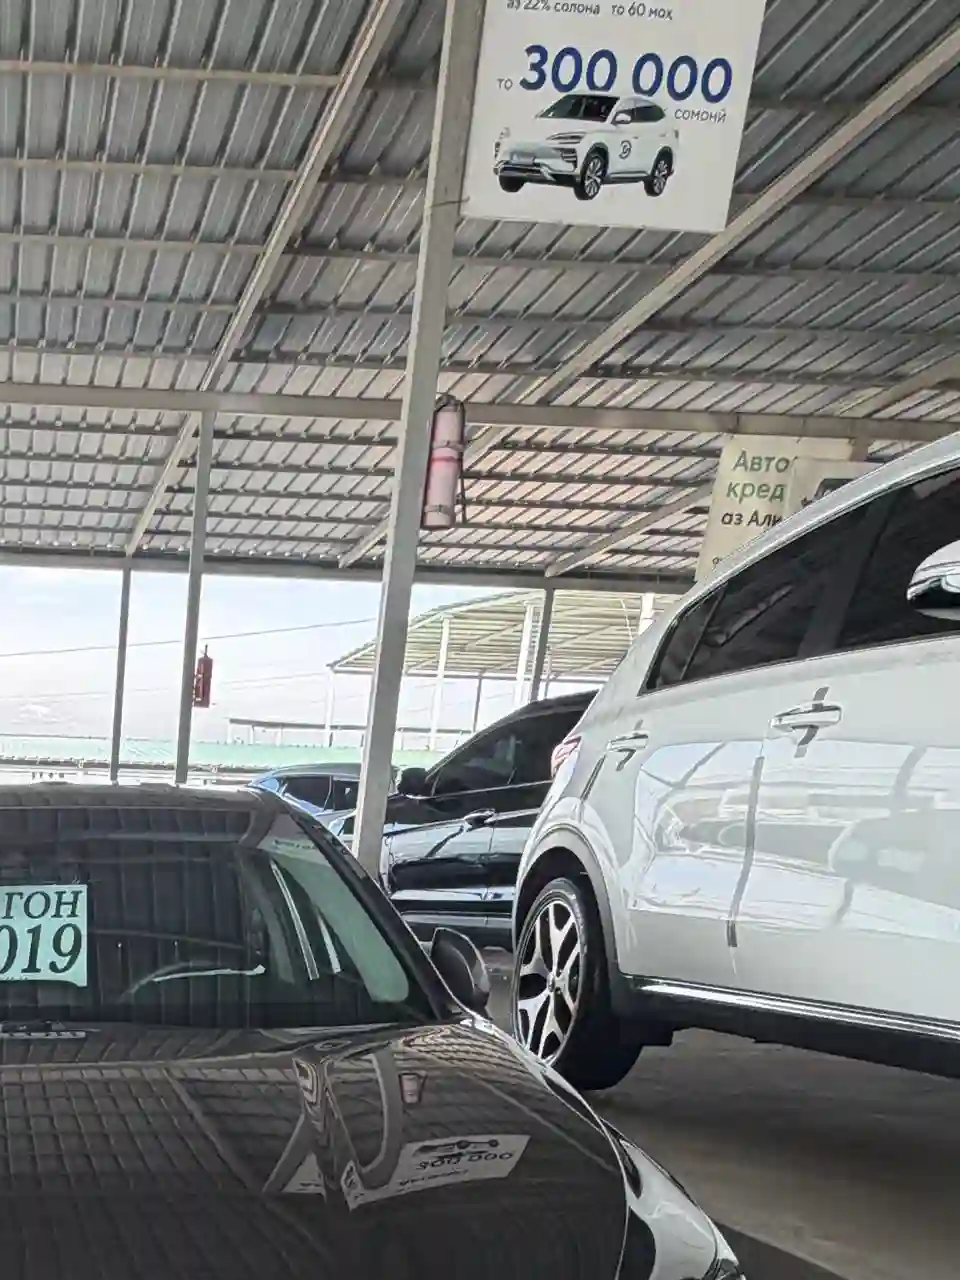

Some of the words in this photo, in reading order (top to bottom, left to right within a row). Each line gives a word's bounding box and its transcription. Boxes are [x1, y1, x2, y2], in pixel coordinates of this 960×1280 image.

[554, 2, 601, 15] солона
[611, 5, 625, 16] то
[628, 2, 646, 17] 60
[496, 78, 514, 92] то
[519, 44, 618, 93] 300
[632, 53, 733, 103] 000
[732, 450, 790, 473] Авто
[721, 512, 744, 525] аз
